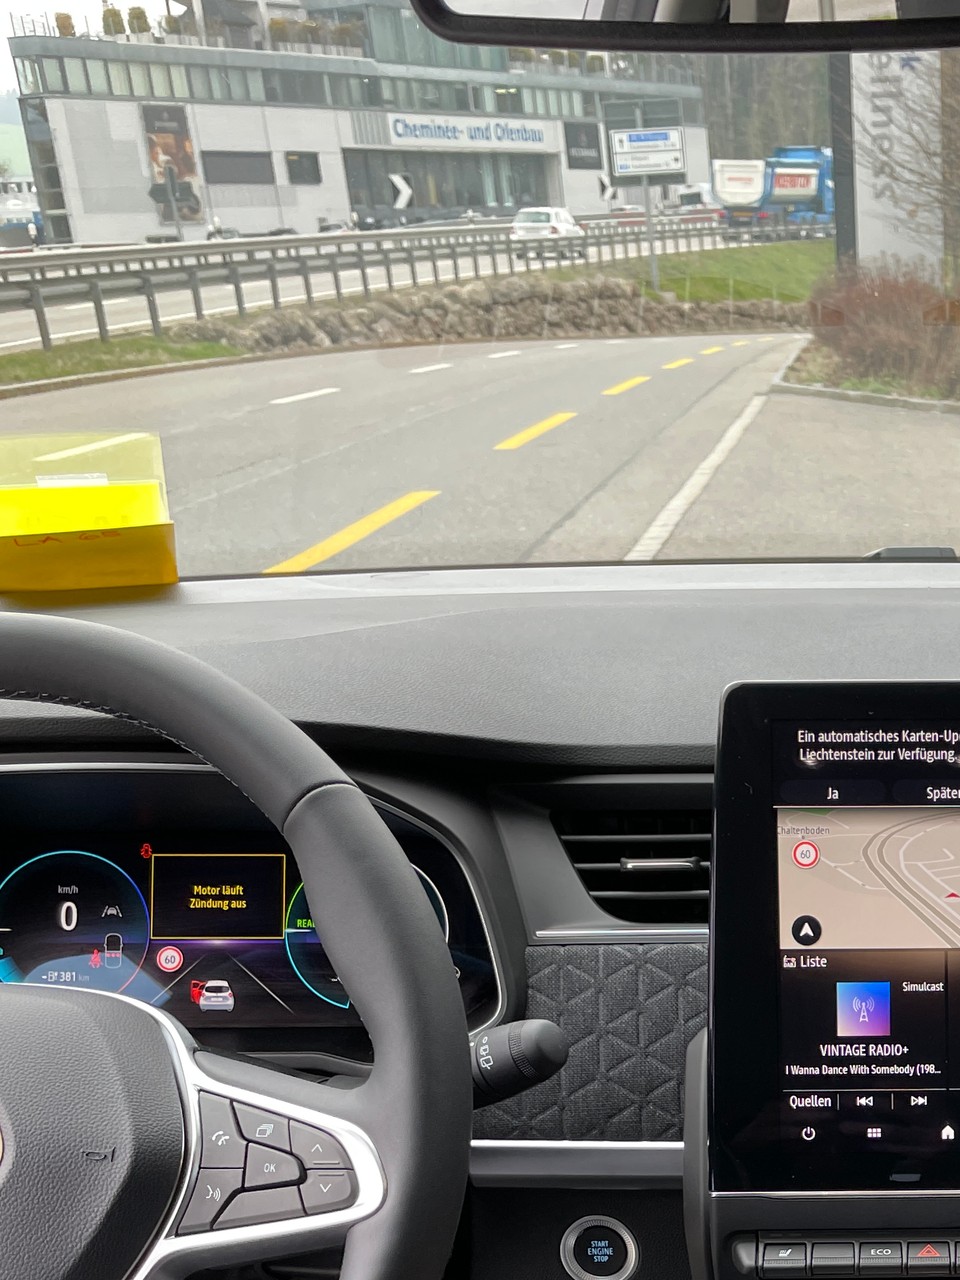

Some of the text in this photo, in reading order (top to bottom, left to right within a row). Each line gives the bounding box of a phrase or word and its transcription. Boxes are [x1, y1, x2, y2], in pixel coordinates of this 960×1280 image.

[467, 123, 491, 141] und
[868, 53, 903, 200] ellness
[797, 730, 815, 743] Ein
[817, 729, 899, 743] automatisches
[799, 747, 875, 761] Liechtenstein
[877, 749, 896, 761] zur
[898, 747, 958, 763] Verfügung.
[827, 787, 839, 800] Ja
[800, 849, 811, 859] 60
[57, 885, 79, 894] km/h
[193, 885, 244, 895] Motor läuft
[189, 898, 247, 911] Zündung aus
[60, 901, 78, 931] 0
[296, 918, 316, 928] REA
[164, 954, 177, 965] 60
[800, 955, 828, 968] Liste
[59, 972, 90, 982] 381 km
[902, 981, 944, 992] Simulcast
[819, 1043, 910, 1057] VINTAGE RADIO+
[790, 1065, 820, 1075] Wanna
[821, 1065, 848, 1075] Dance
[849, 1064, 870, 1075] With
[871, 1064, 915, 1077] Somebody
[789, 1094, 832, 1110] Quellen
[263, 1163, 276, 1173] OK
[590, 1240, 609, 1248] START
[587, 1247, 614, 1256] ENGINE
[870, 1247, 892, 1256] ECO
[593, 1255, 609, 1263] STOP
